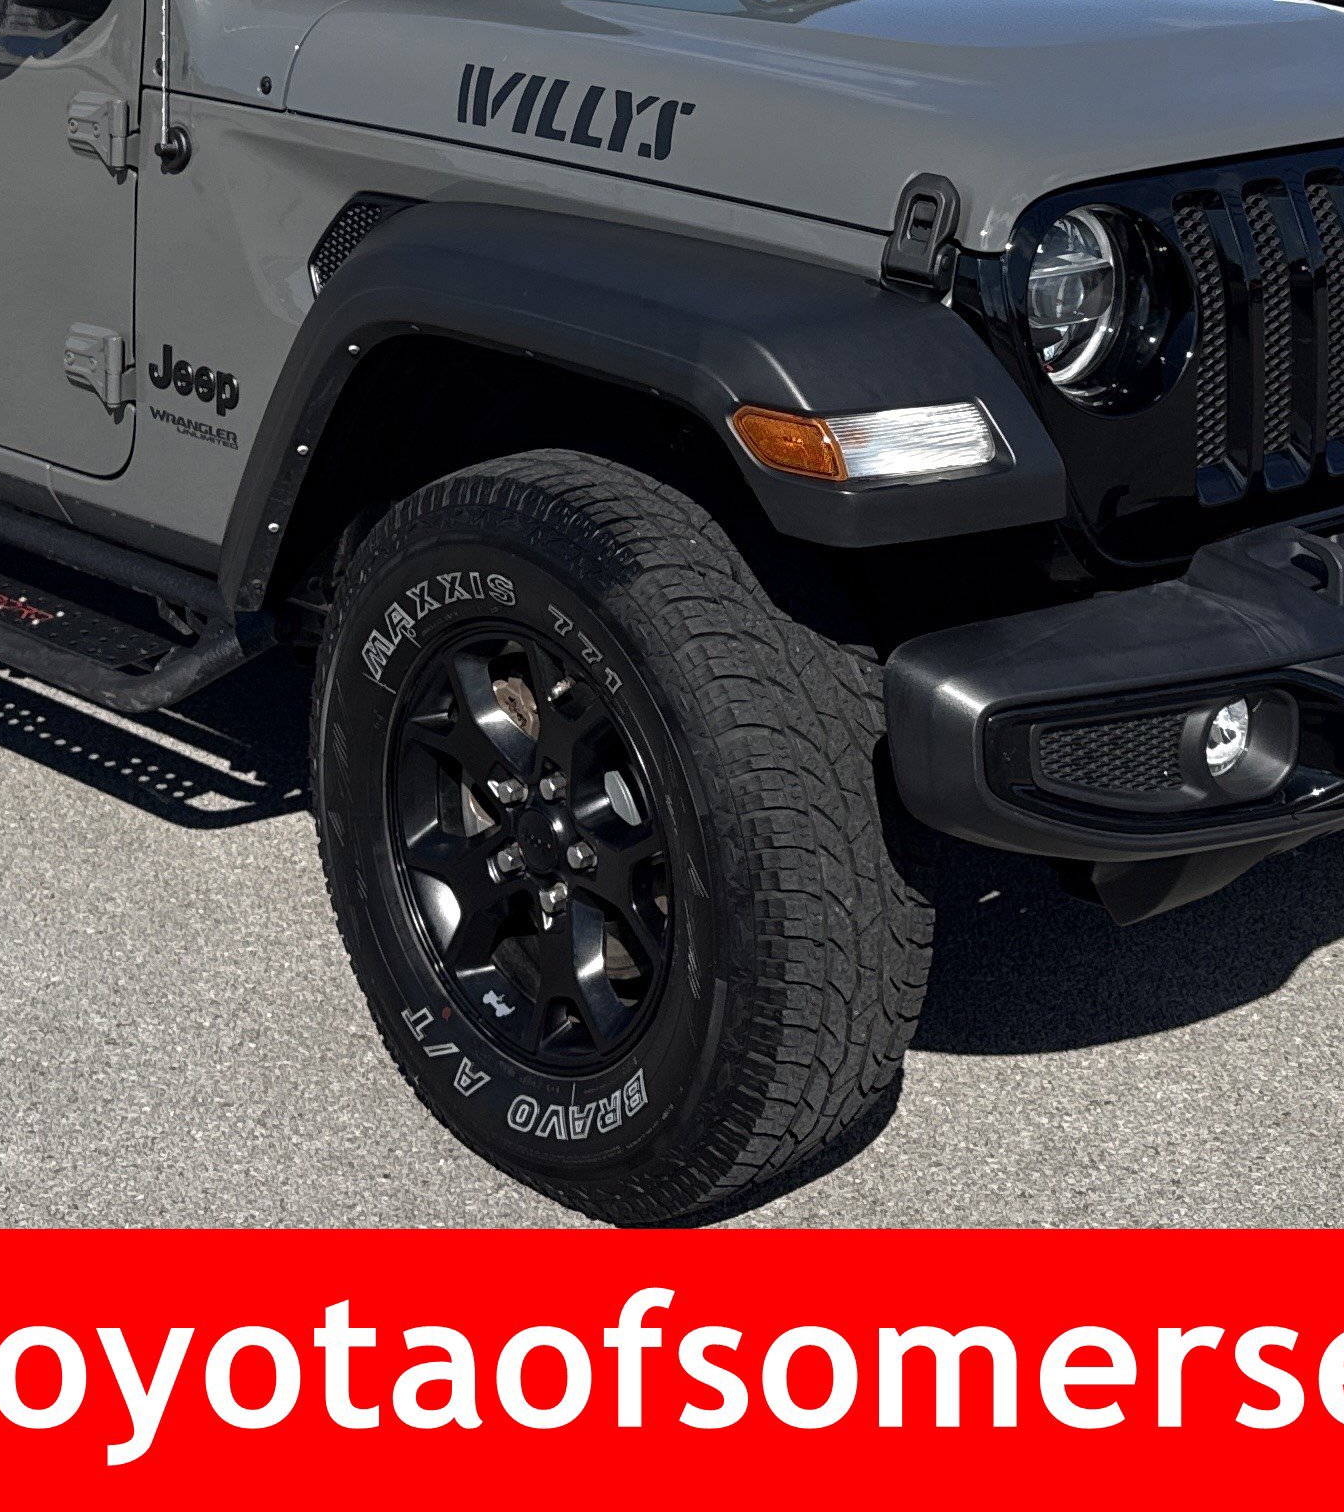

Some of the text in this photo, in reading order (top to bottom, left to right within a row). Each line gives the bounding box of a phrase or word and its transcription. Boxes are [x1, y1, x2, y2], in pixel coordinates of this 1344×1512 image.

[457, 63, 696, 160] WILLYS
[149, 343, 240, 417] Jeep
[150, 405, 238, 443] WRANGLER
[177, 426, 239, 450] UNLIMITED
[362, 571, 516, 681] MAXXIS
[401, 1007, 649, 1141] BRAVO A/T
